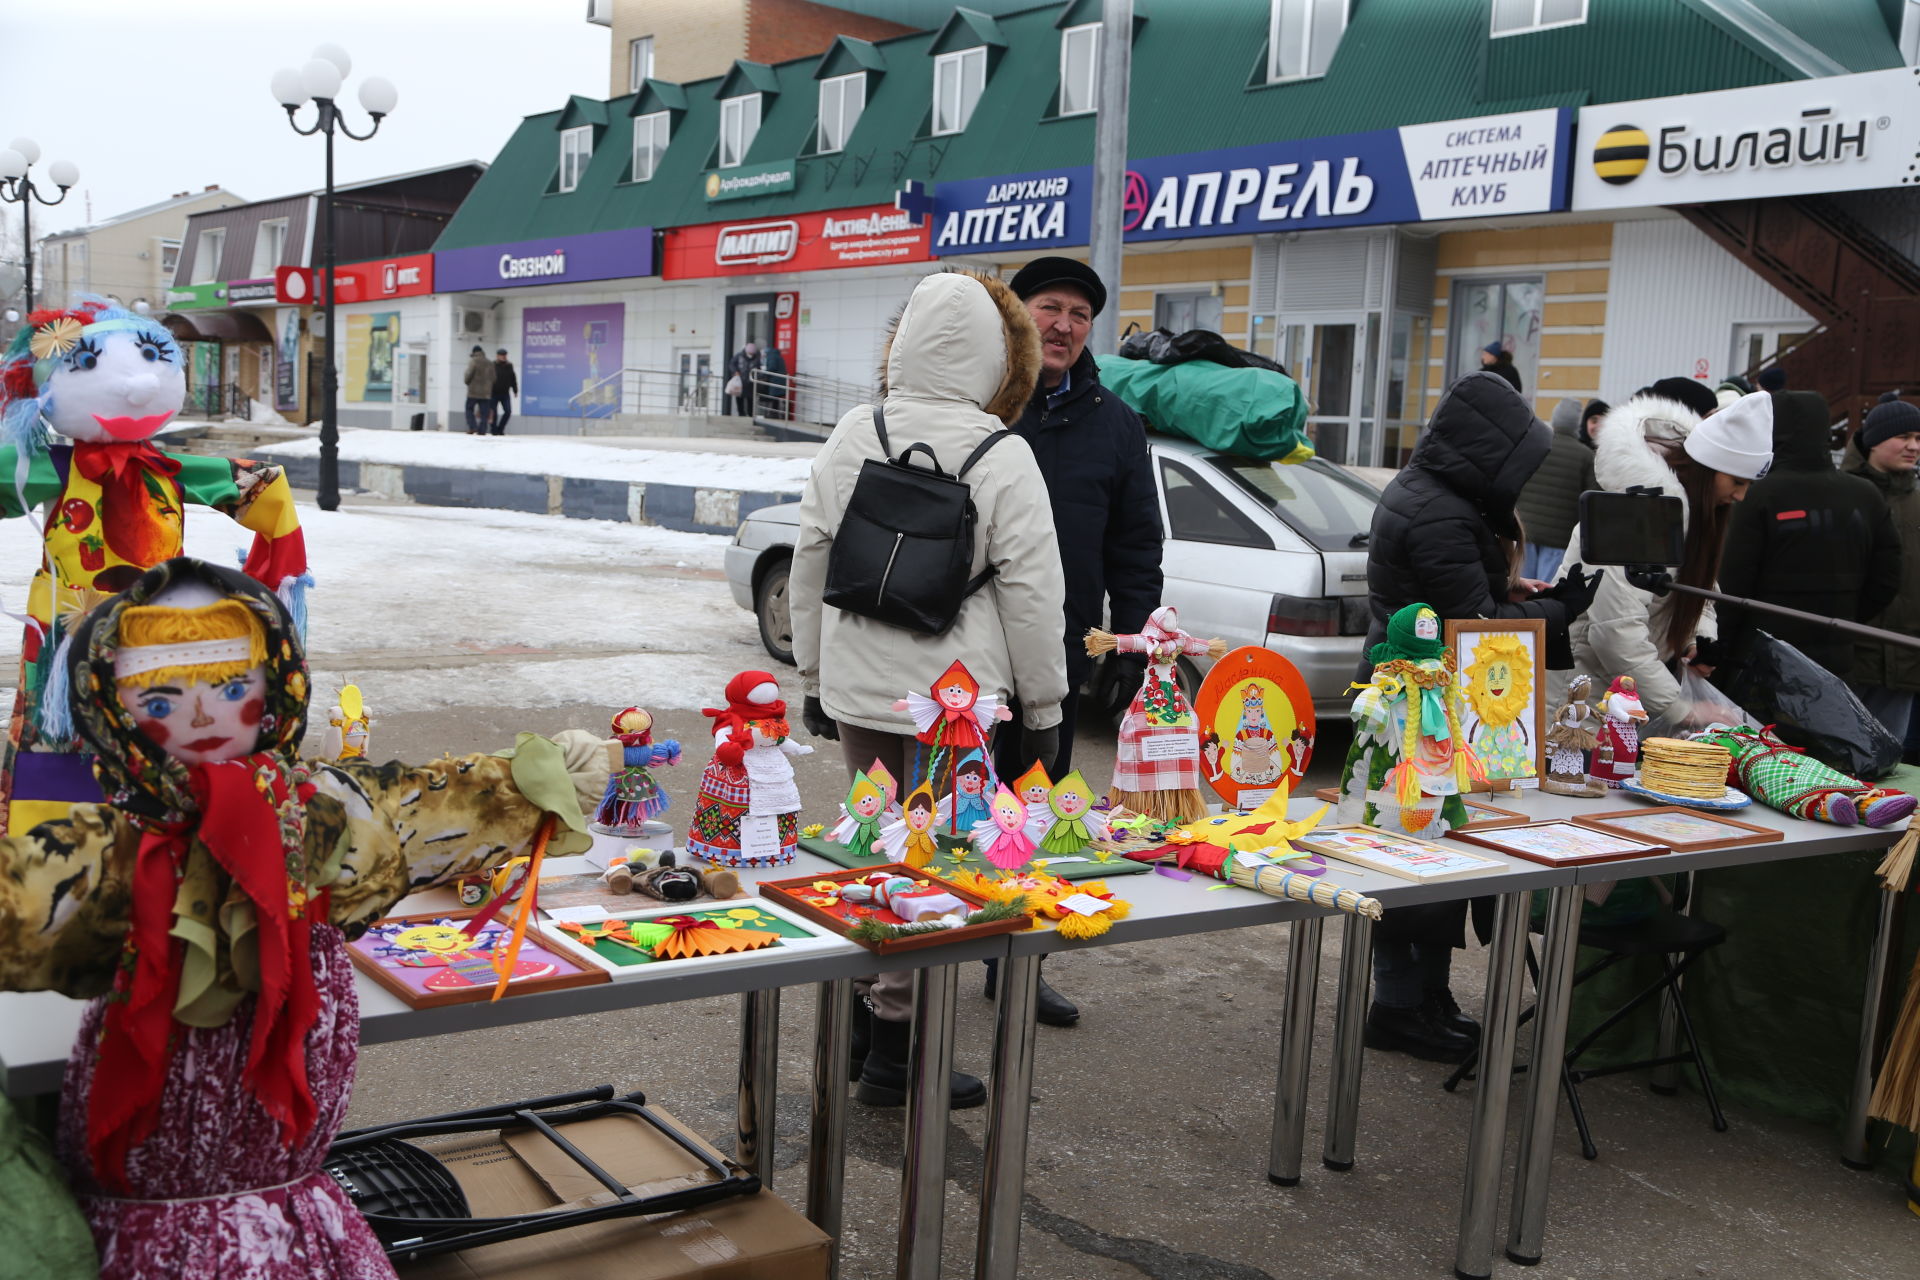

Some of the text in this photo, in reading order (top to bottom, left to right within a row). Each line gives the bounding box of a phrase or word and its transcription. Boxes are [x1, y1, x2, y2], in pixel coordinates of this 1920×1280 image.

[1445, 124, 1523, 148] СИСТЕМА
[1658, 106, 1867, 174] Билайн
[1419, 143, 1548, 181] АПТЕЧНЫЙ
[985, 176, 1069, 204] ДАРУХАНӘ
[1140, 156, 1375, 231] АПРЕЛЬ
[1450, 182, 1508, 207] КЛУБ
[936, 200, 1066, 247] АПТЕКА
[721, 229, 791, 257] МАГНИТ
[499, 249, 565, 279] Связной
